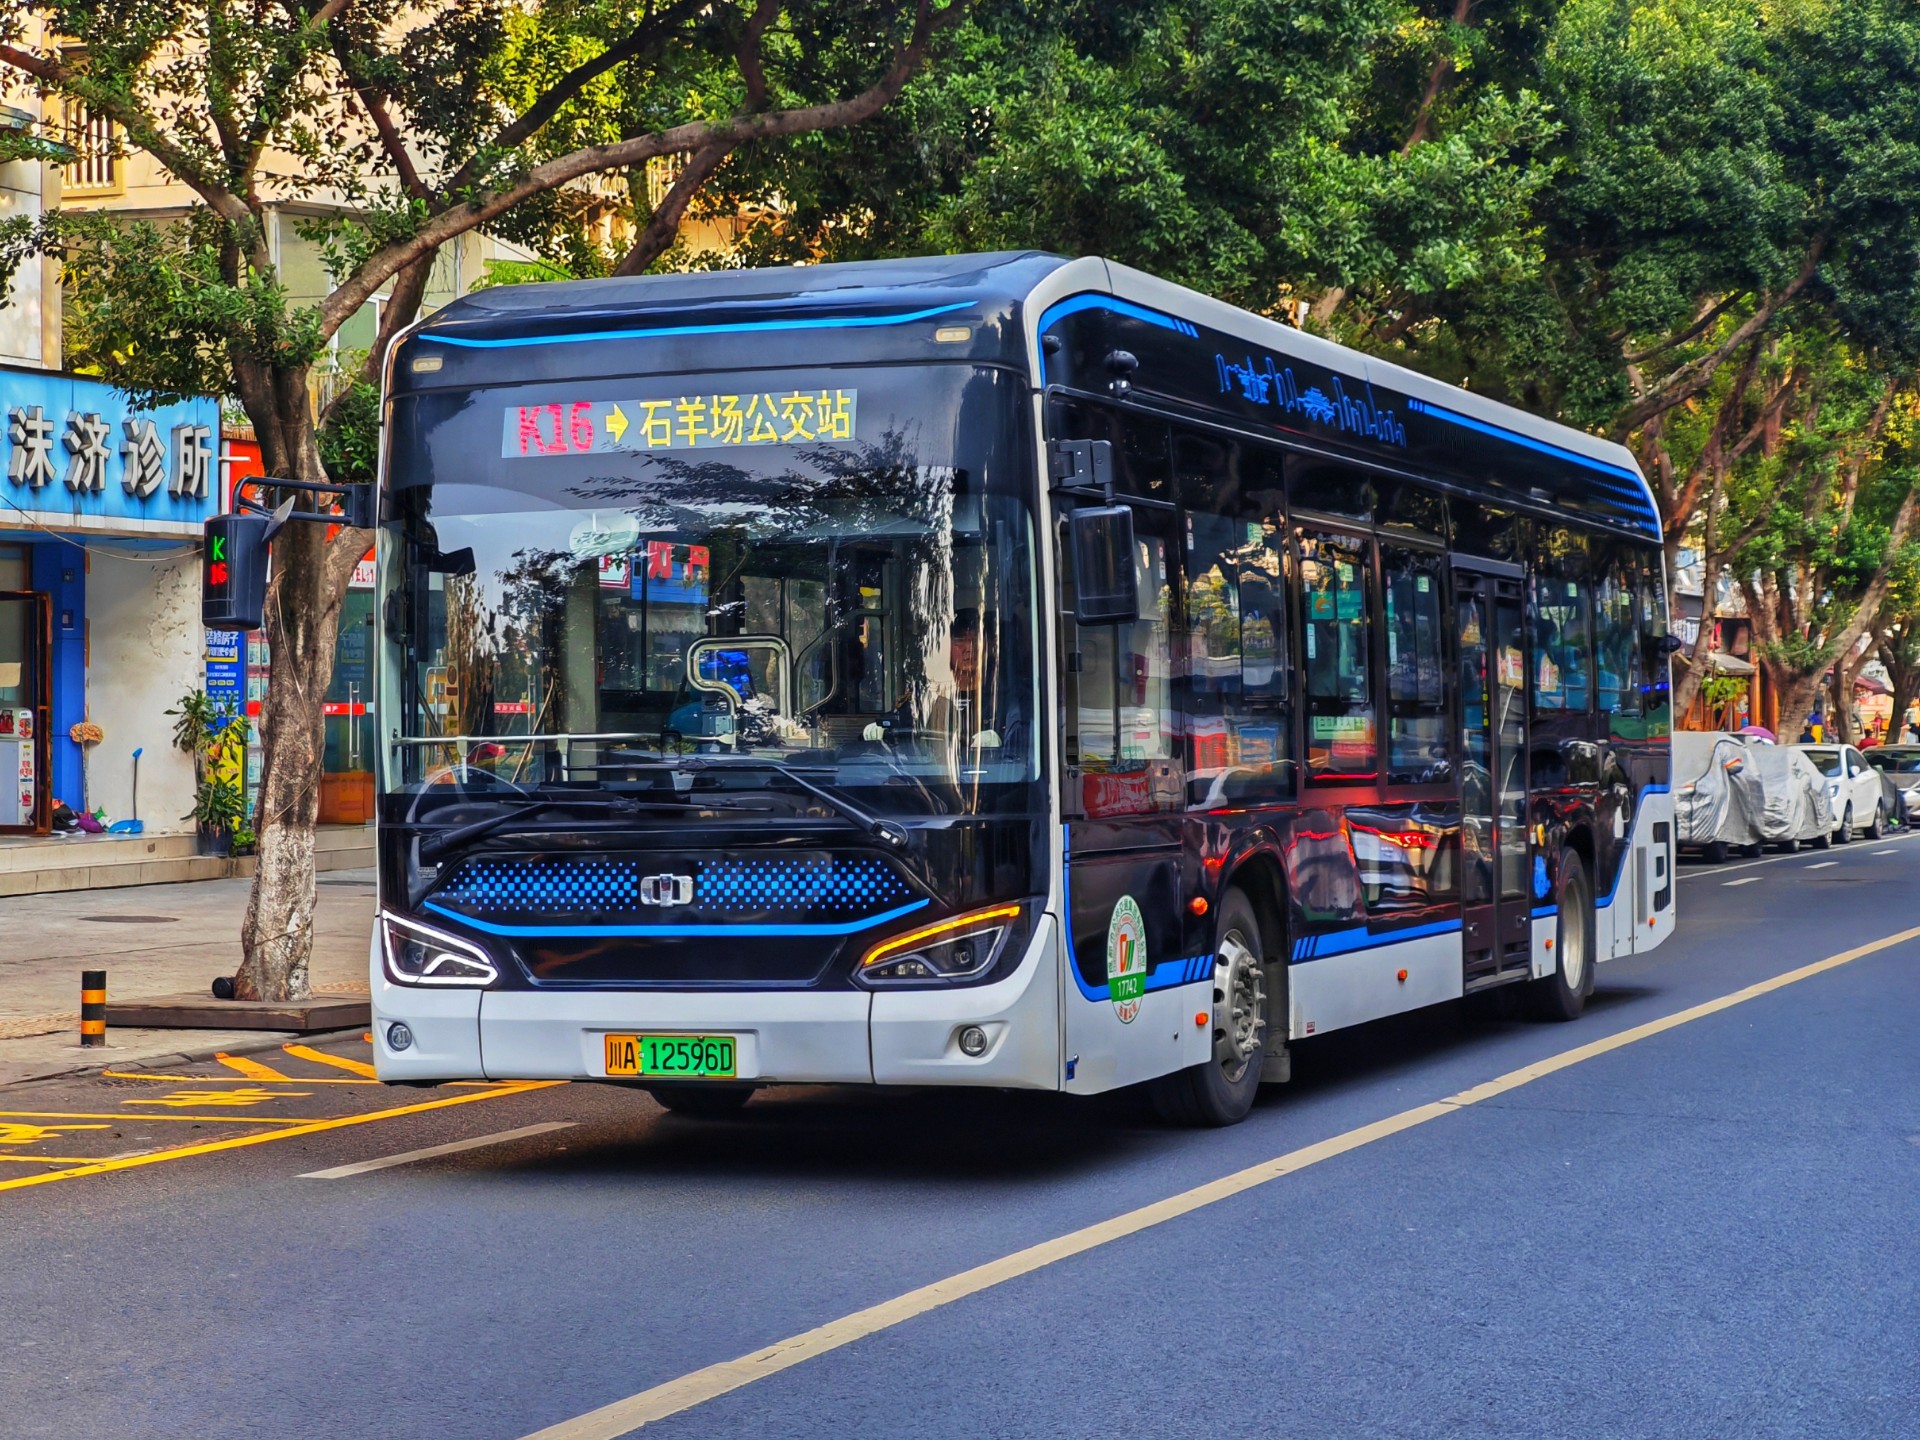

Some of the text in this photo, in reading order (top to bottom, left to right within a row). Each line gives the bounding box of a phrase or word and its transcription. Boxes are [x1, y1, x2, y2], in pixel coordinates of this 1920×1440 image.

[518, 388, 852, 455] K16 石羊场公交站
[213, 535, 226, 561] K
[1117, 977, 1138, 998] 17742
